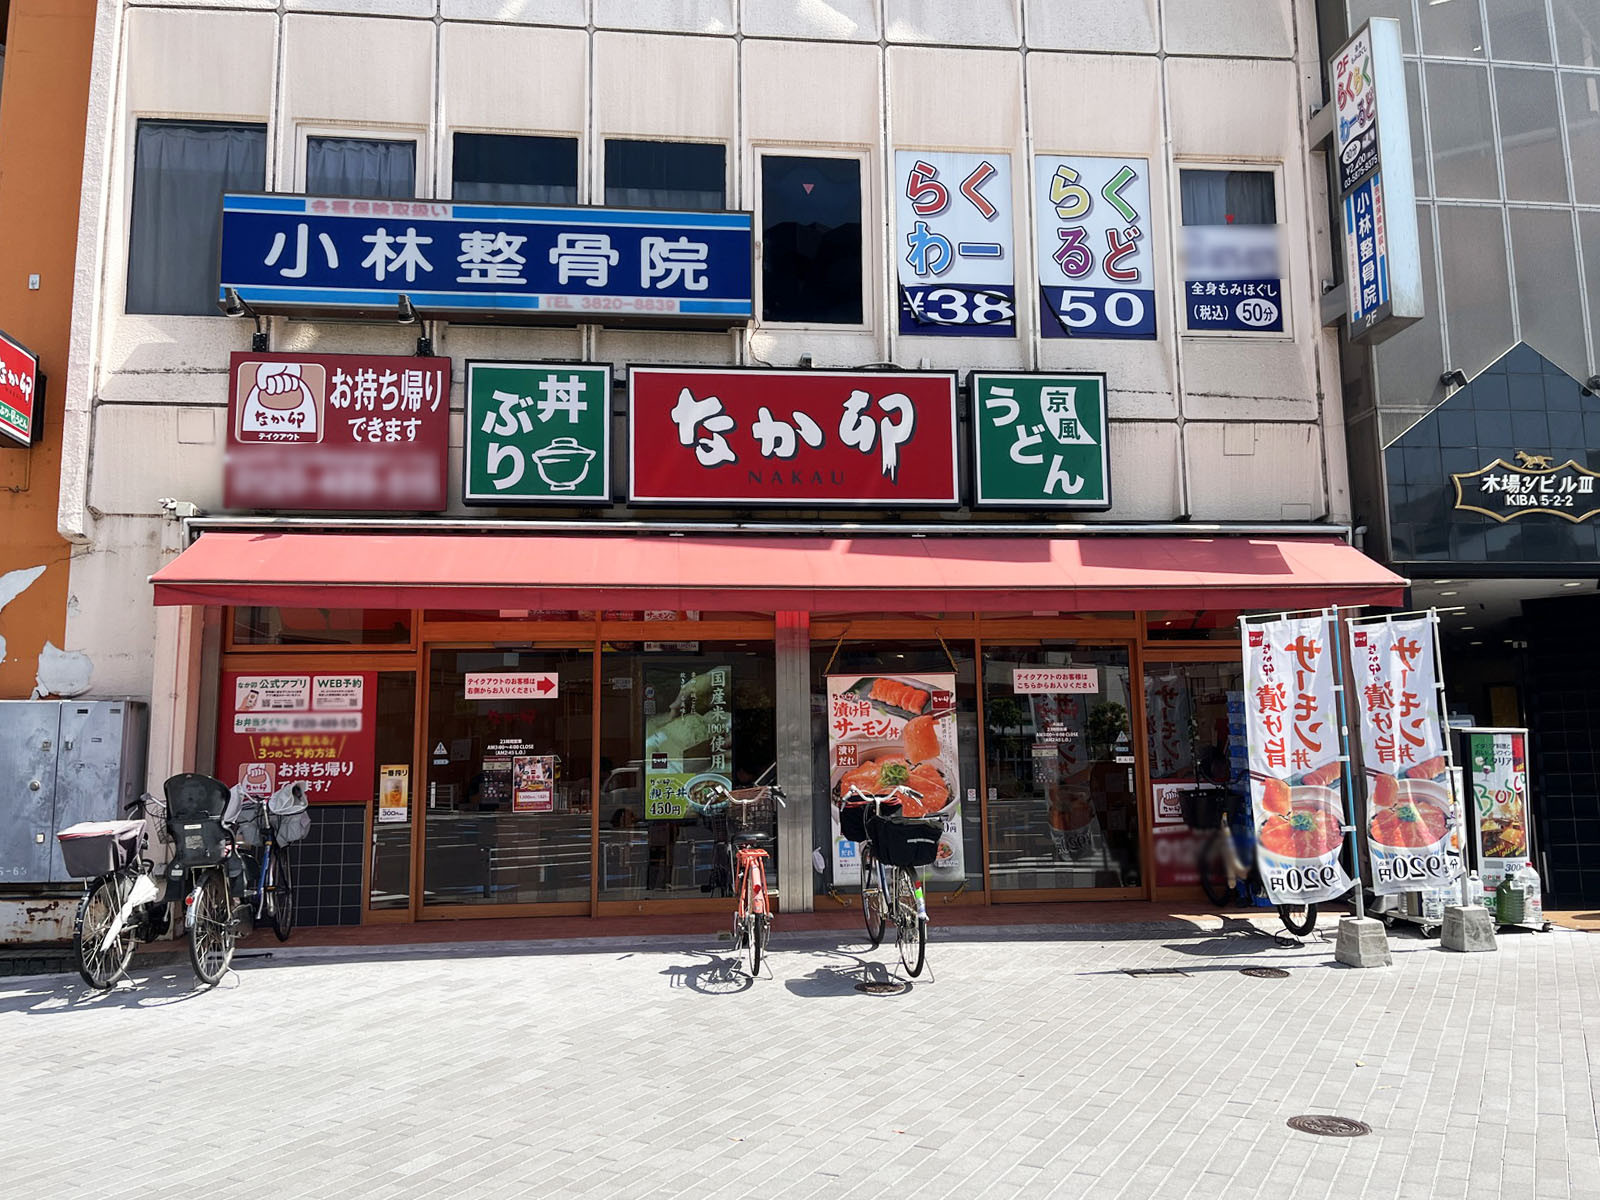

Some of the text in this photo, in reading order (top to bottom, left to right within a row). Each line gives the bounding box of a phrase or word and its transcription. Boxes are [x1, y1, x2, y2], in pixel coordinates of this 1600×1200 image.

[263, 223, 709, 291] 小林整骨院
[1356, 191, 1378, 310] 小林整骨院
[1191, 282, 1278, 296] 全身もみほぐし
[546, 296, 676, 311] TEL 3820-8839
[1059, 289, 1144, 328] 50
[1242, 302, 1274, 322] 50分
[1365, 309, 1378, 328] 2F
[329, 367, 443, 412] お持ち帰り
[254, 410, 306, 429] なか卯
[1044, 390, 1081, 441] 京風
[257, 432, 300, 441] テイクアウト
[347, 416, 422, 442] できます
[670, 387, 914, 482] なか卯
[984, 385, 1085, 495] うどん
[748, 469, 846, 485] NAKAU
[1506, 494, 1574, 506] KIBA 5-2-2
[259, 679, 307, 689] 公式アプリ
[317, 679, 362, 689] WEB予約
[467, 687, 536, 695] 右側からお入りください
[833, 701, 871, 718] 漬け旨
[832, 717, 900, 739] サーモン丼
[258, 748, 337, 759] 3つのご予約方法
[838, 744, 856, 755] 漬け
[278, 761, 354, 777] お持ち帰り
[838, 756, 856, 766] だれ
[649, 801, 682, 816] 450円
